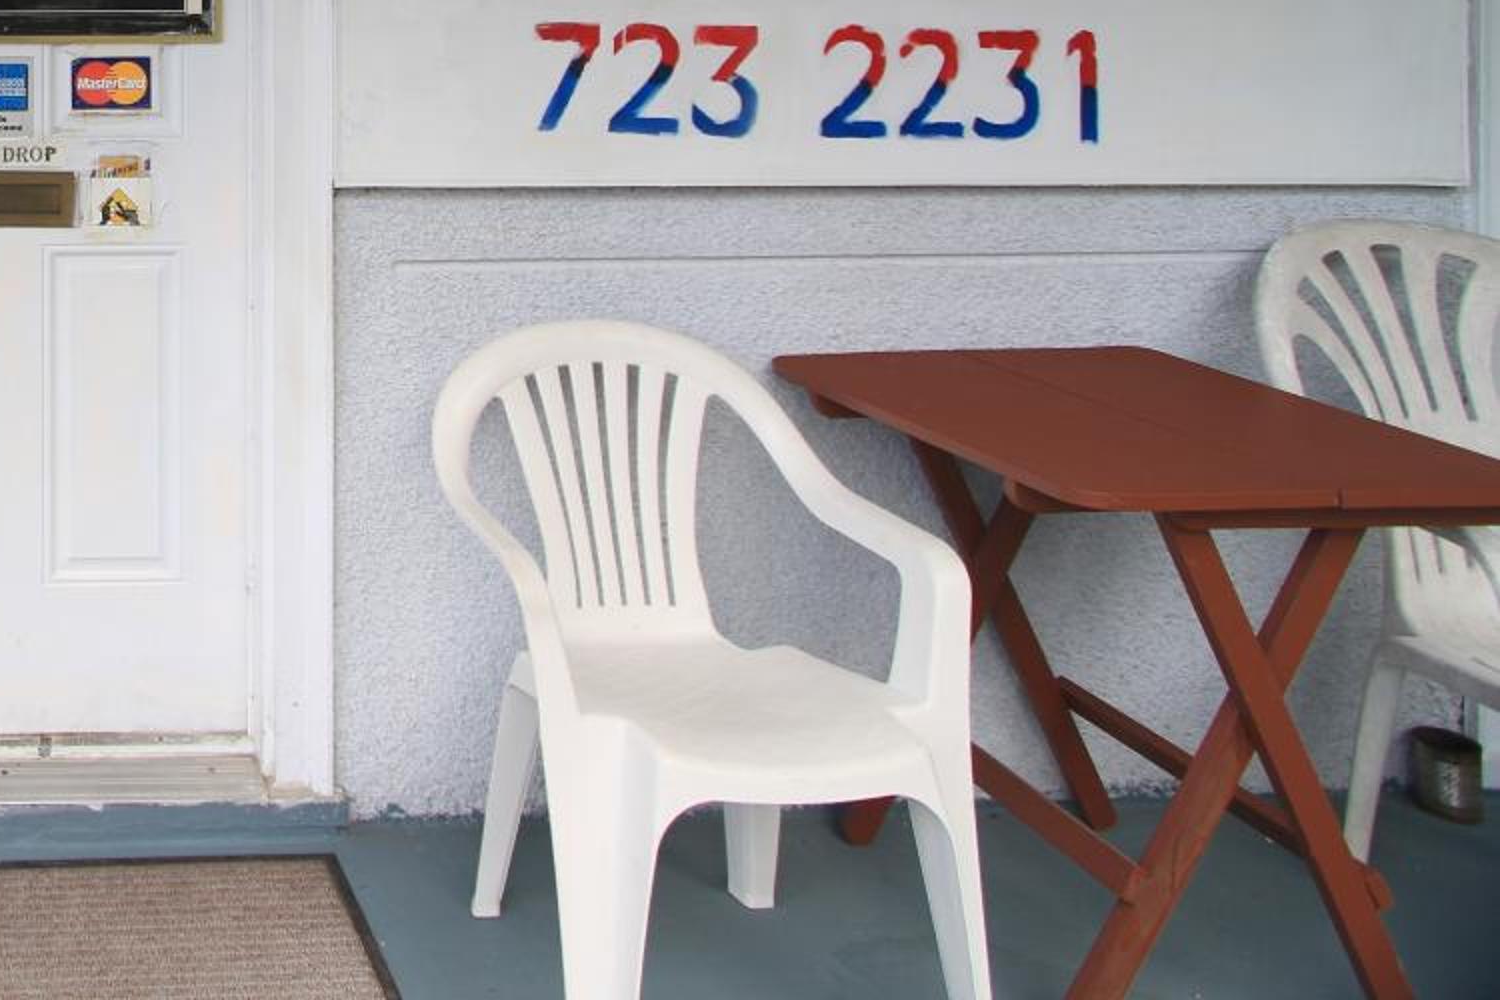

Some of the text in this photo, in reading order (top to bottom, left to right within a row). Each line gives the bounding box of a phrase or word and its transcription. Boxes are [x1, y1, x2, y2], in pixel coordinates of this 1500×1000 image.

[534, 23, 1099, 143] 723 2231
[3, 146, 57, 163] DROP
